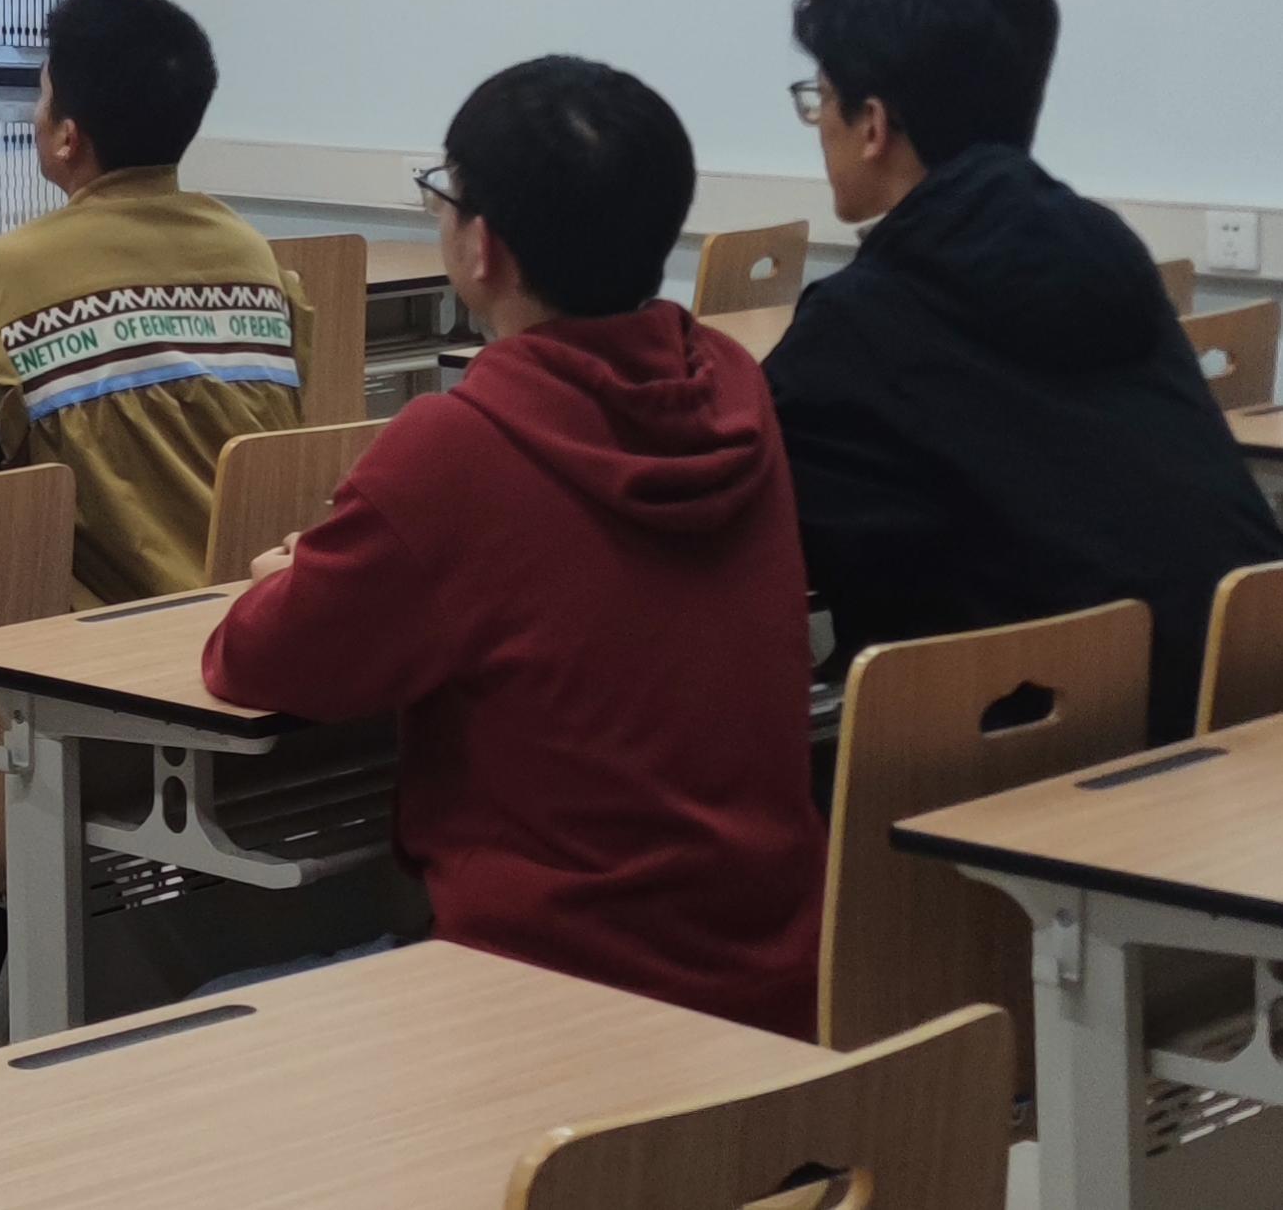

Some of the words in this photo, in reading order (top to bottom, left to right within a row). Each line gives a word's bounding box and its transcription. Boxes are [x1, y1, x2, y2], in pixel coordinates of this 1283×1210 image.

[10, 326, 98, 376] ENETTON
[114, 317, 138, 341] OF
[140, 314, 216, 337] BENETTON
